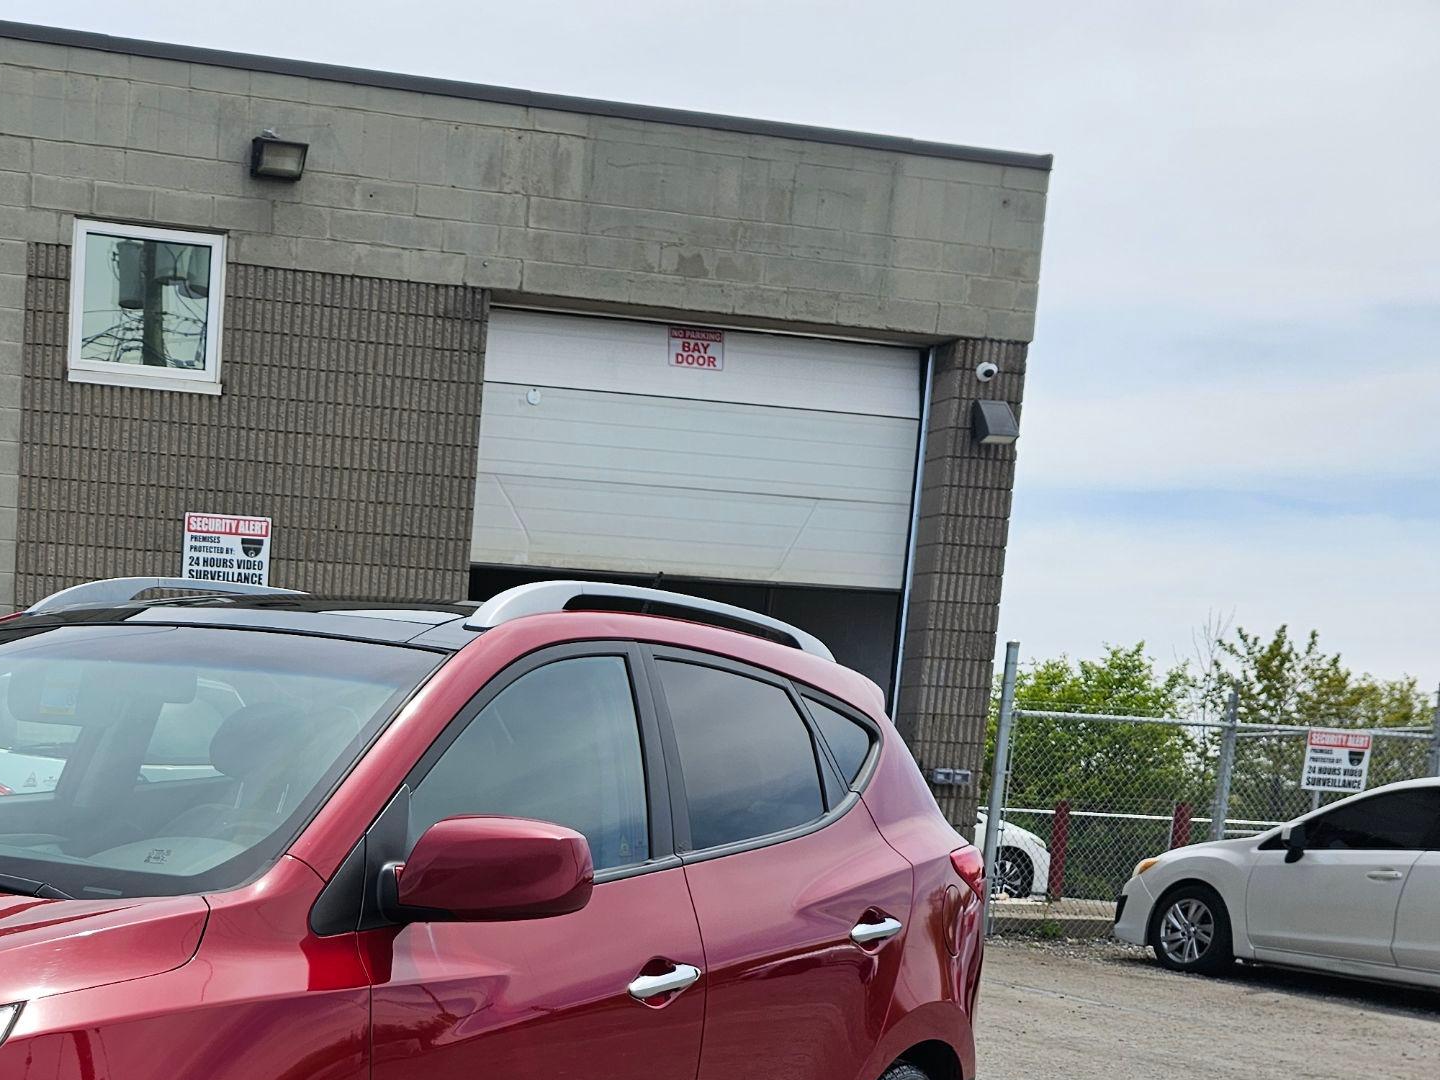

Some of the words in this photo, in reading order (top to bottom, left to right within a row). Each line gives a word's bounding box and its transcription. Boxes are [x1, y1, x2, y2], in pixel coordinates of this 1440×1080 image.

[672, 329, 684, 338] NO
[685, 330, 722, 341] PARKING
[682, 341, 710, 354] BAY
[675, 353, 717, 367] DOOR
[189, 516, 239, 533] SECURITY
[239, 520, 268, 535] ALERT
[190, 534, 221, 544] PREMISES
[190, 545, 224, 555] PROTECTED
[189, 556, 200, 567] 24
[203, 557, 234, 569] HOURS
[237, 559, 263, 571] VIDEO
[188, 569, 263, 586] SURVEILLANCE
[1306, 776, 1361, 789] SURVEILLANCE
